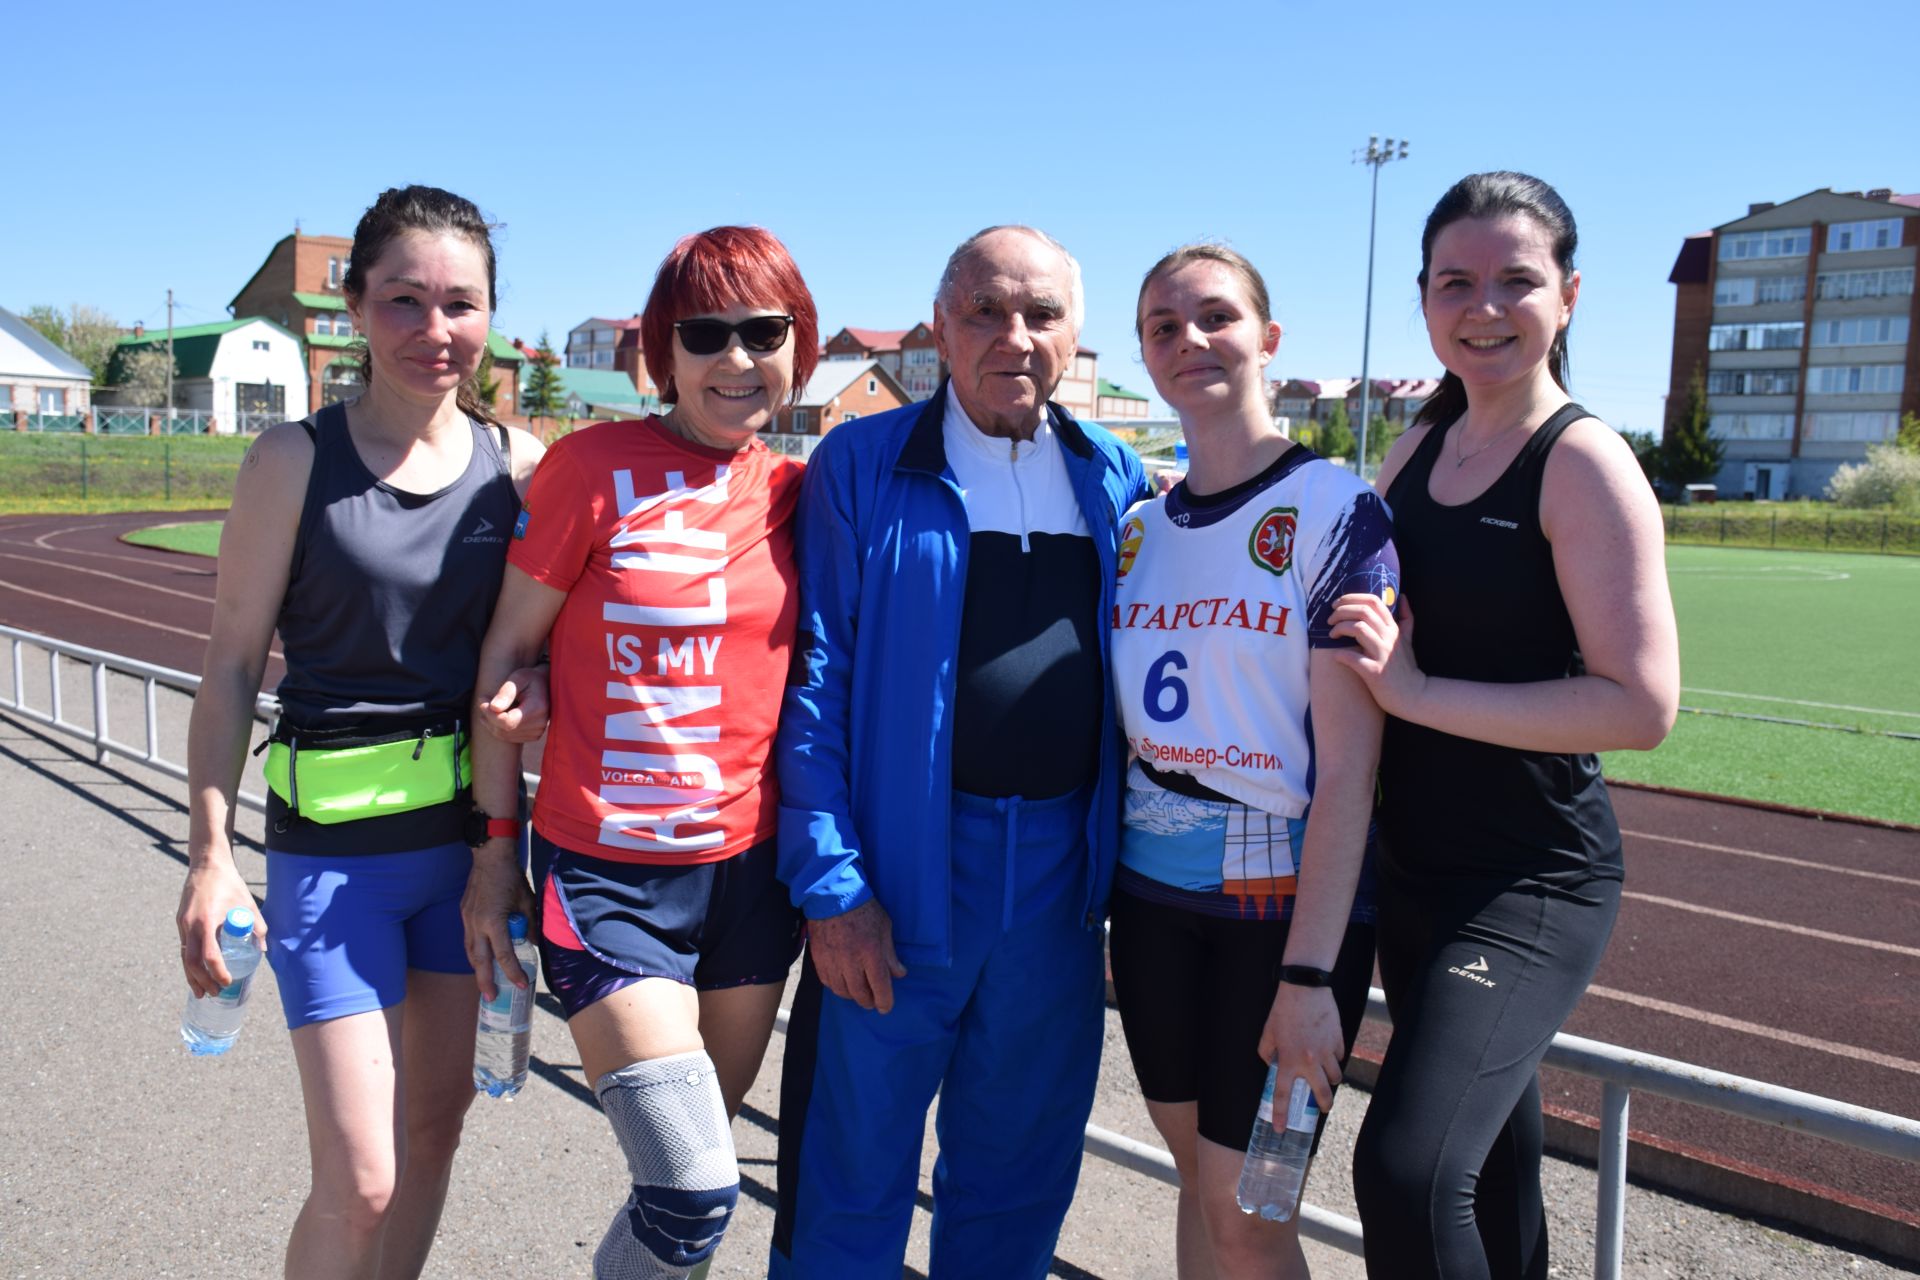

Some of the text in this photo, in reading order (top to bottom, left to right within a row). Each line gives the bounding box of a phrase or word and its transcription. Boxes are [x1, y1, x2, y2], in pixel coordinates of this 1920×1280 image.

[462, 536, 505, 544] DEMIX
[1480, 517, 1519, 530] KICKERS
[603, 464, 732, 627] LIFE
[1111, 598, 1292, 636] АТАРСТАН
[606, 632, 723, 676] IS MY
[1143, 650, 1189, 722] 6
[598, 681, 726, 852] RUN
[1448, 966, 1497, 988] DEMIX
